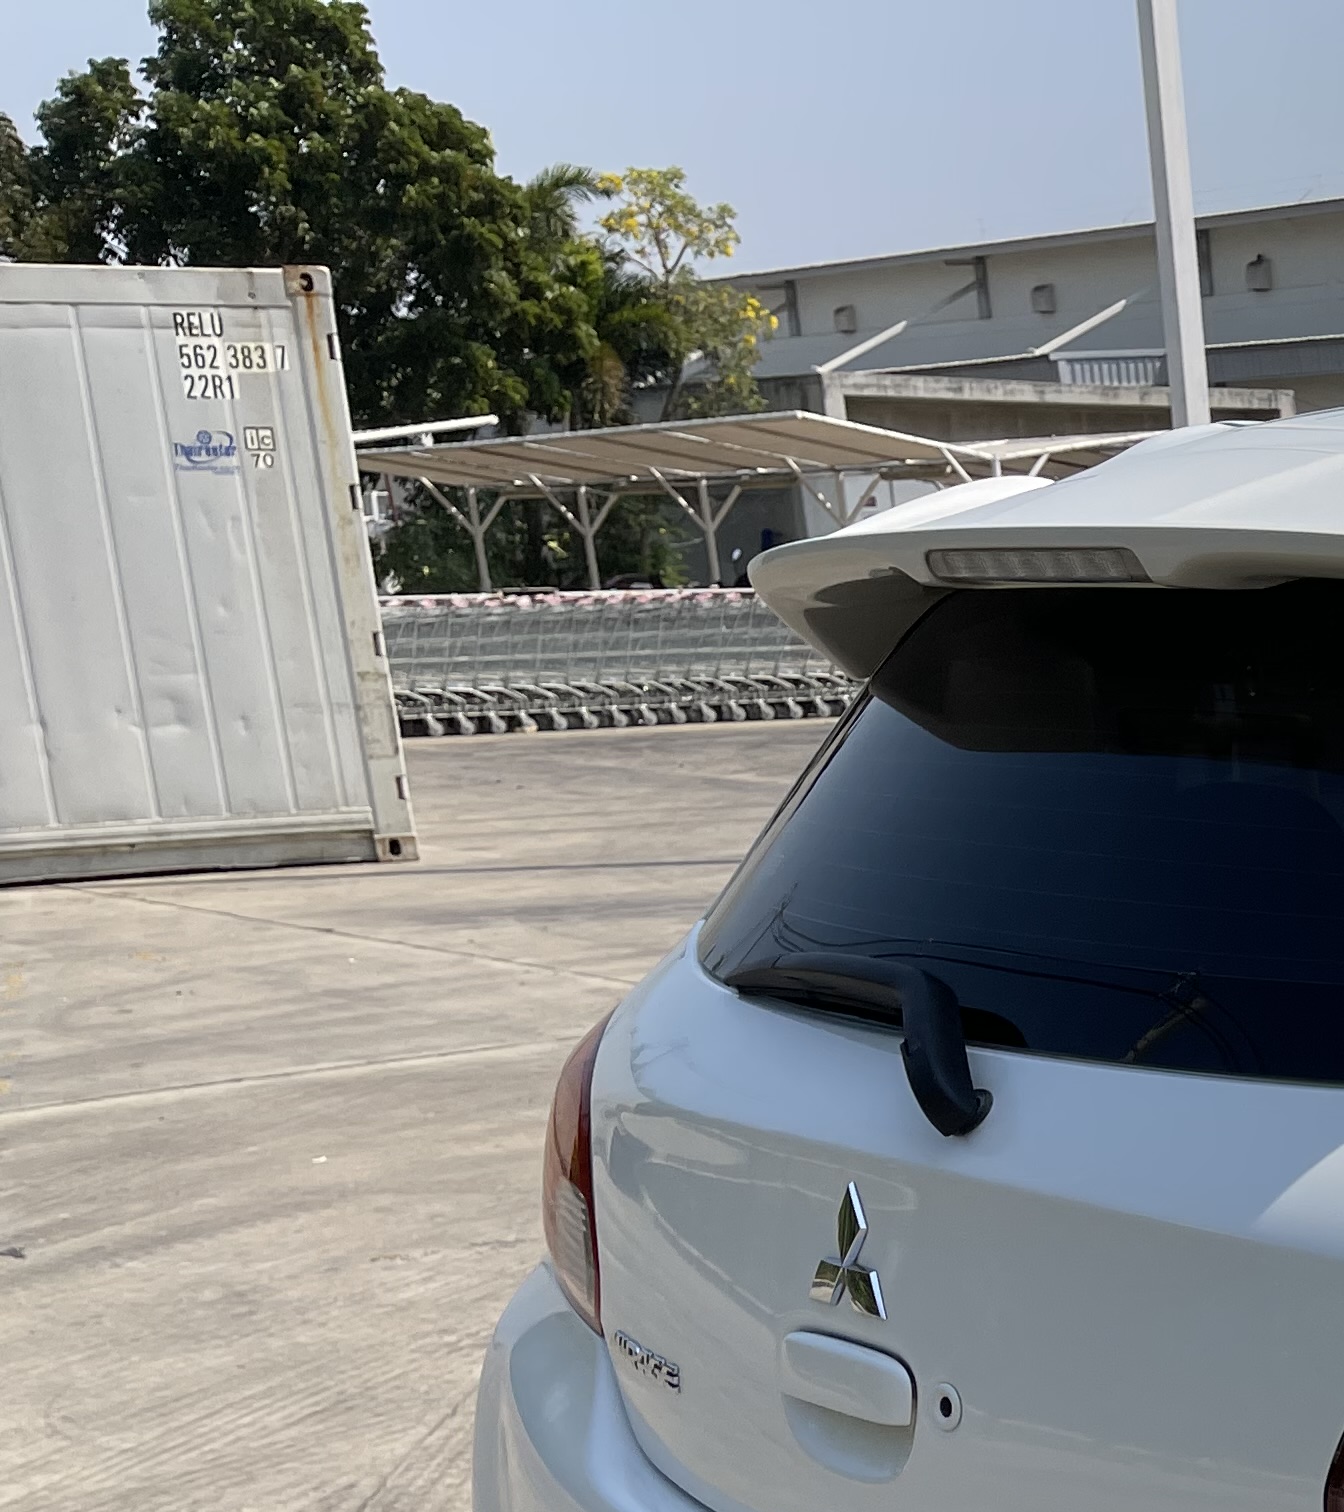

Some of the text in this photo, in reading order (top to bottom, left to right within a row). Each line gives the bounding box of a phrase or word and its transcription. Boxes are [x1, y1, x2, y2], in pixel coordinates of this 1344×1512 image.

[172, 311, 224, 338] RELU
[178, 343, 286, 370] 562 383 7
[183, 374, 235, 400] 22R1
[250, 453, 275, 469] 70
